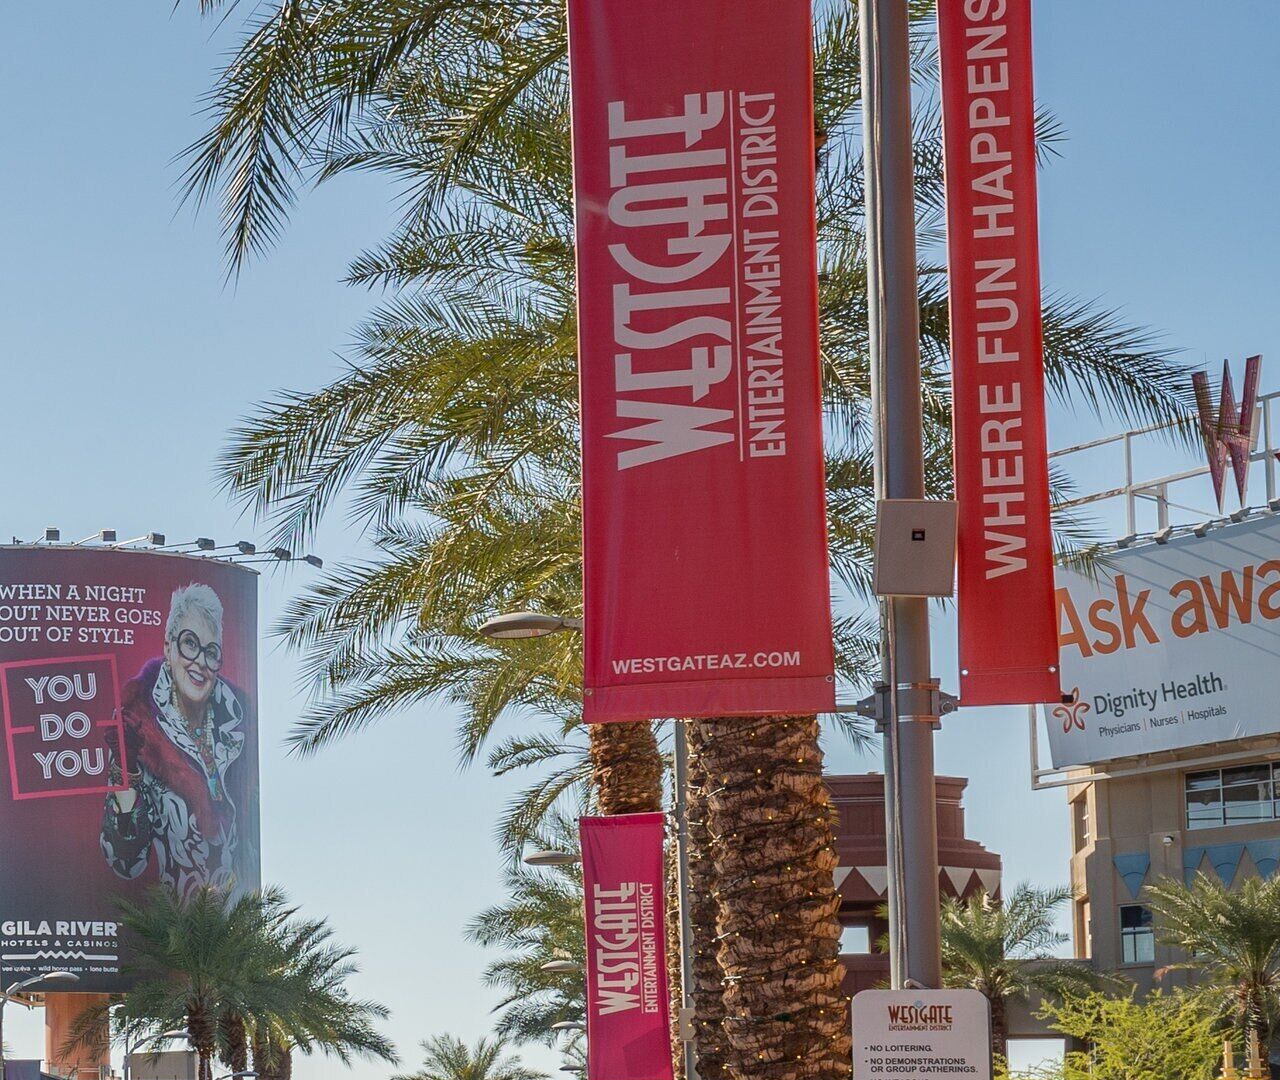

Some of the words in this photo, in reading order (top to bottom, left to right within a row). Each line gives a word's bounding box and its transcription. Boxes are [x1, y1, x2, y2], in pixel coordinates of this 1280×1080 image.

[965, 0, 1016, 239] HAPPENS
[739, 91, 779, 219] DISTRICT
[602, 90, 735, 471] WESTGATE
[976, 257, 1021, 365] FUN
[743, 228, 786, 458] ENTERTAINMENT
[981, 381, 1028, 581] WHERE
[66, 585, 81, 600] A
[85, 585, 146, 604] NIGHT
[46, 605, 111, 622] NEVER
[115, 608, 162, 626] GOES
[1056, 574, 1161, 659] Ask
[46, 627, 73, 642] OF
[78, 629, 134, 644] STYLE
[612, 651, 801, 674] WESTGATEAZ.COM
[25, 672, 97, 704] YOU
[1094, 687, 1157, 719] Dignity
[1162, 671, 1224, 703] Health
[40, 711, 91, 741] DO
[1098, 719, 1141, 737] Physicians
[1149, 713, 1179, 728] Nurses
[1187, 704, 1227, 722] Hospitals
[33, 747, 105, 779] YOU
[640, 882, 655, 928] DISTRICT
[1, 920, 52, 936] GILA
[56, 921, 118, 936] RIVER
[67, 940, 118, 948] CASINOS
[593, 881, 640, 1015] WESTGATE
[643, 930, 658, 1013] ENTERTAINMENT
[888, 1005, 952, 1023] WESTGATE
